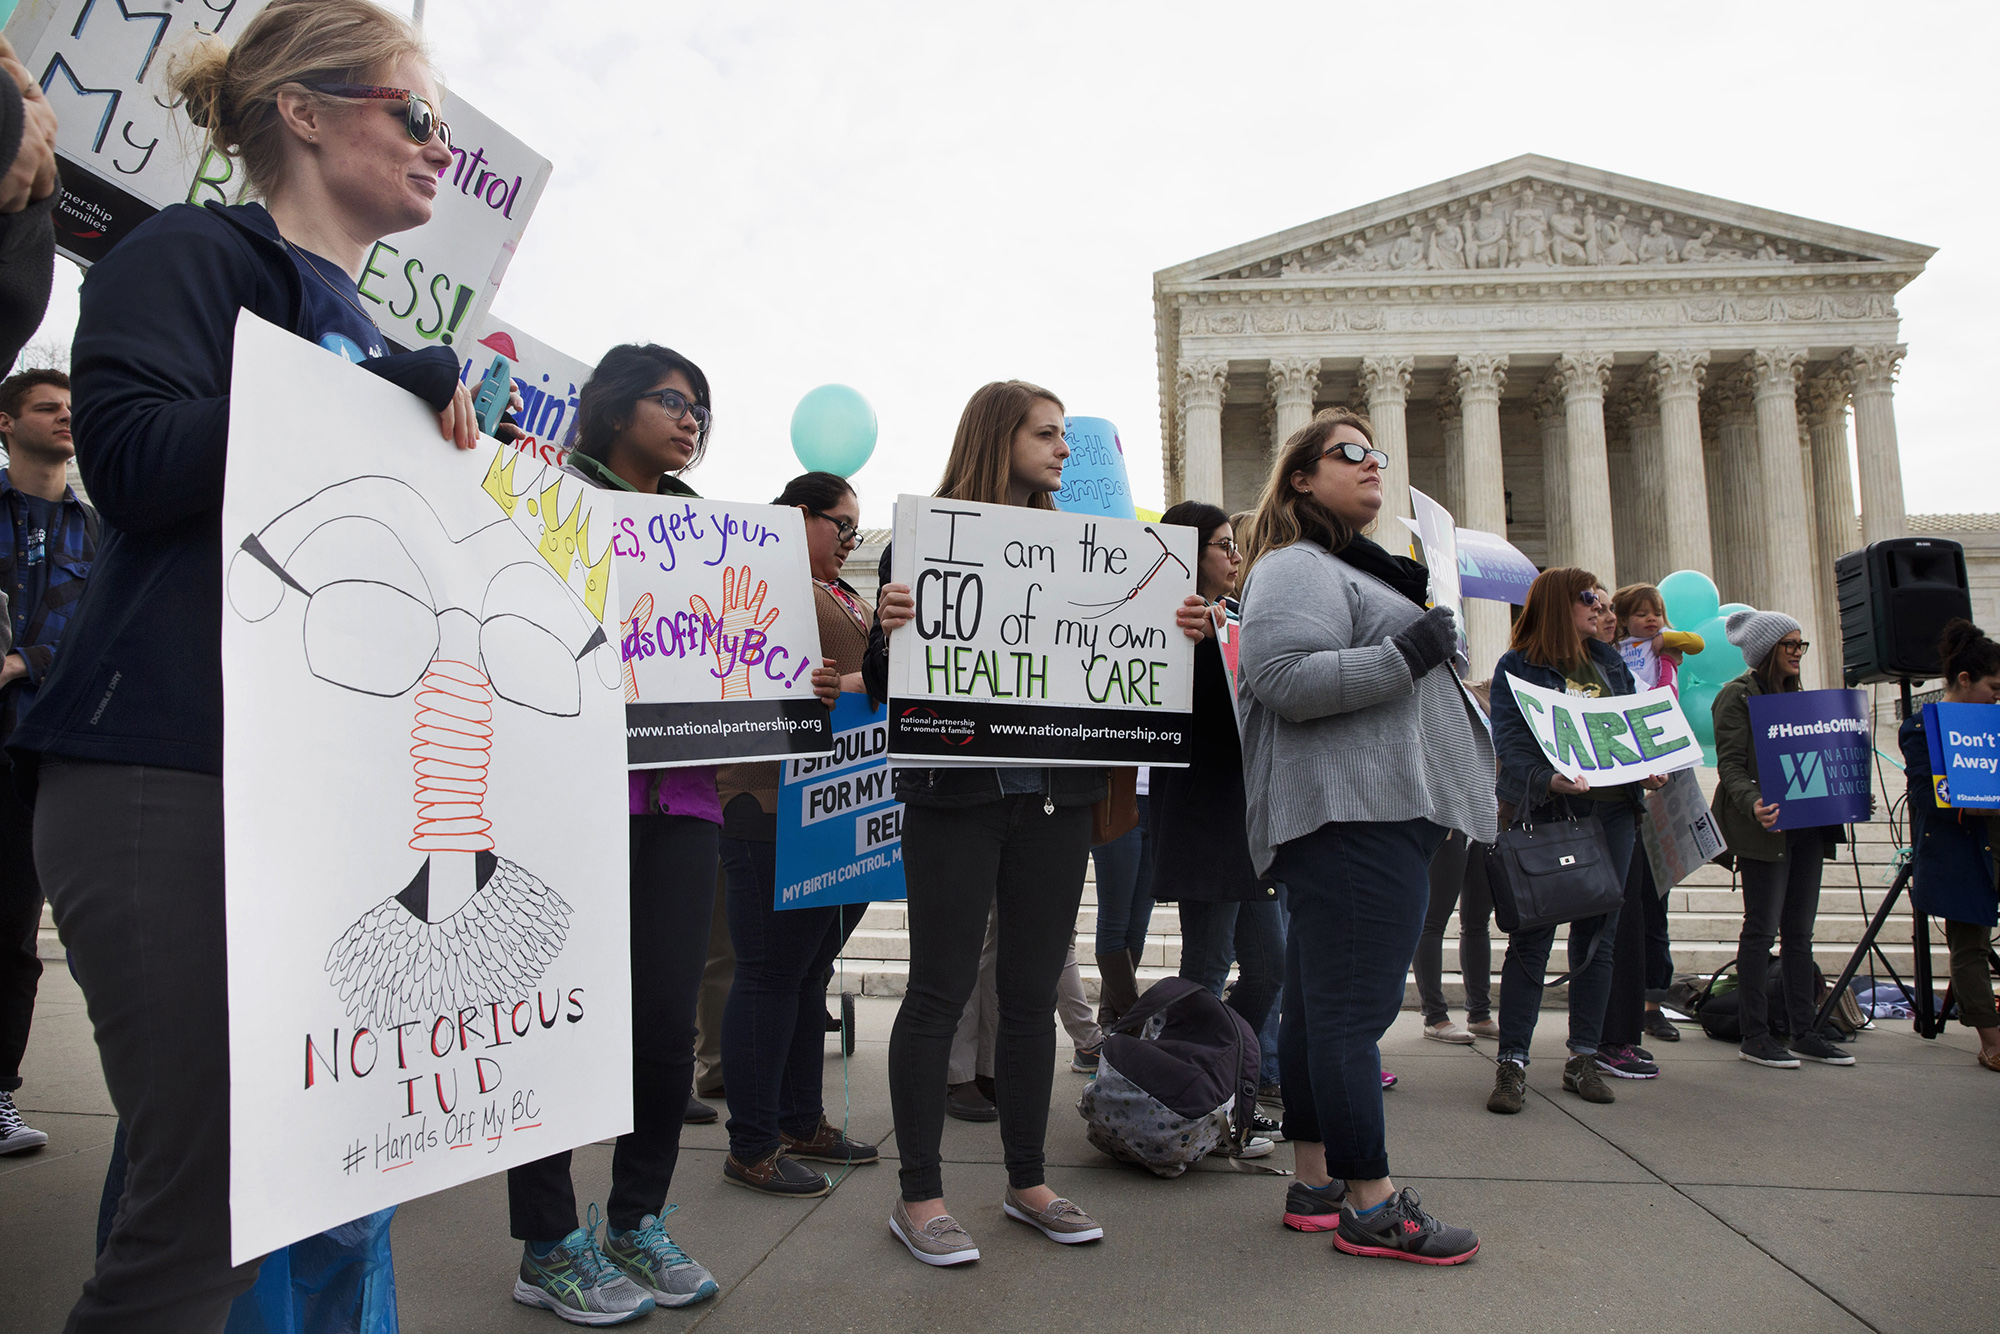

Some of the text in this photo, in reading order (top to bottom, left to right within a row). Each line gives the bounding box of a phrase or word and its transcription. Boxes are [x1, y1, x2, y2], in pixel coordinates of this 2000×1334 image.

[38, 51, 159, 175] My
[59, 200, 108, 233] families
[1398, 305, 1668, 326] EQUAL JUSTICE UNDER LAW
[648, 503, 704, 572] get
[703, 513, 780, 566] your
[924, 508, 1128, 575] I am the
[915, 568, 1167, 672] CEO of my own
[90, 670, 122, 725] DOUBLE DRY
[925, 645, 1169, 707] HEALTH CARE
[626, 716, 823, 740] www.nationalpartnership.org
[900, 716, 976, 728] national partnership
[900, 724, 912, 733] for
[913, 726, 940, 734] women
[948, 726, 975, 736] families
[990, 723, 1182, 744] www.nationalpartnership.org
[1513, 689, 1692, 771] CARE
[1948, 731, 1997, 748] Don't
[1830, 781, 1855, 796] LAW
[1952, 752, 1999, 774] Away
[810, 780, 852, 820] FOR
[856, 769, 887, 805] MY
[782, 882, 801, 903] MY
[803, 870, 838, 897] BIRTH
[837, 851, 891, 883] CONTROL,
[304, 987, 585, 1090] NOTORIOUS
[398, 1057, 503, 1118] IUD
[444, 1111, 476, 1147] Off
[482, 1100, 506, 1154] My
[511, 1089, 541, 1124] BC
